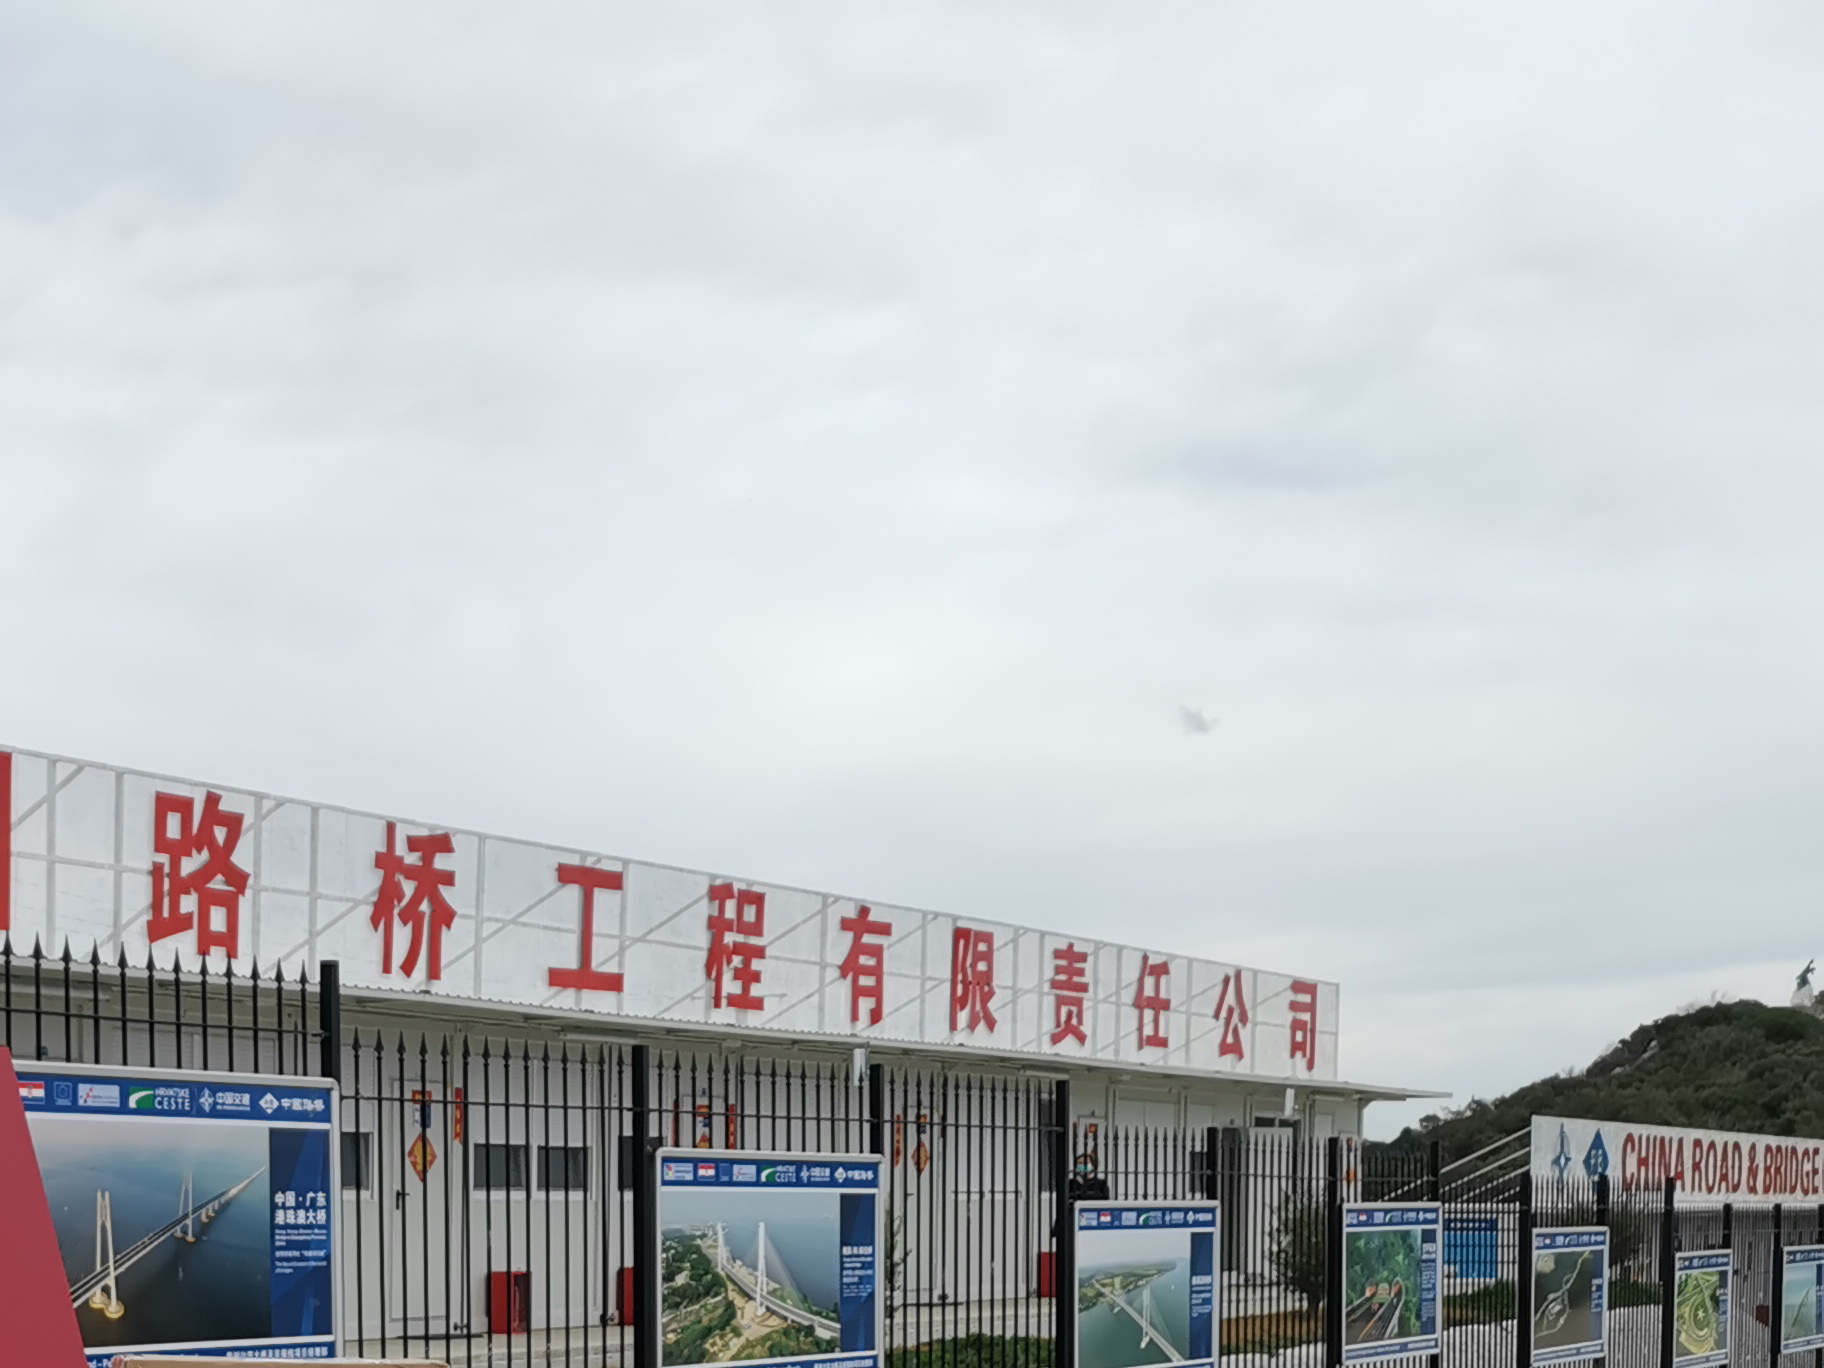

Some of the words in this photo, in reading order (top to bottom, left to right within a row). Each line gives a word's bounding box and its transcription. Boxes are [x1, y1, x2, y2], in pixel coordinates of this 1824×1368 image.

[154, 1098, 190, 1111] CESTE
[1622, 1131, 1685, 1192] CHINA
[1691, 1136, 1743, 1194] ROAD
[1747, 1141, 1759, 1196] &
[1762, 1143, 1821, 1197] BRIDGE
